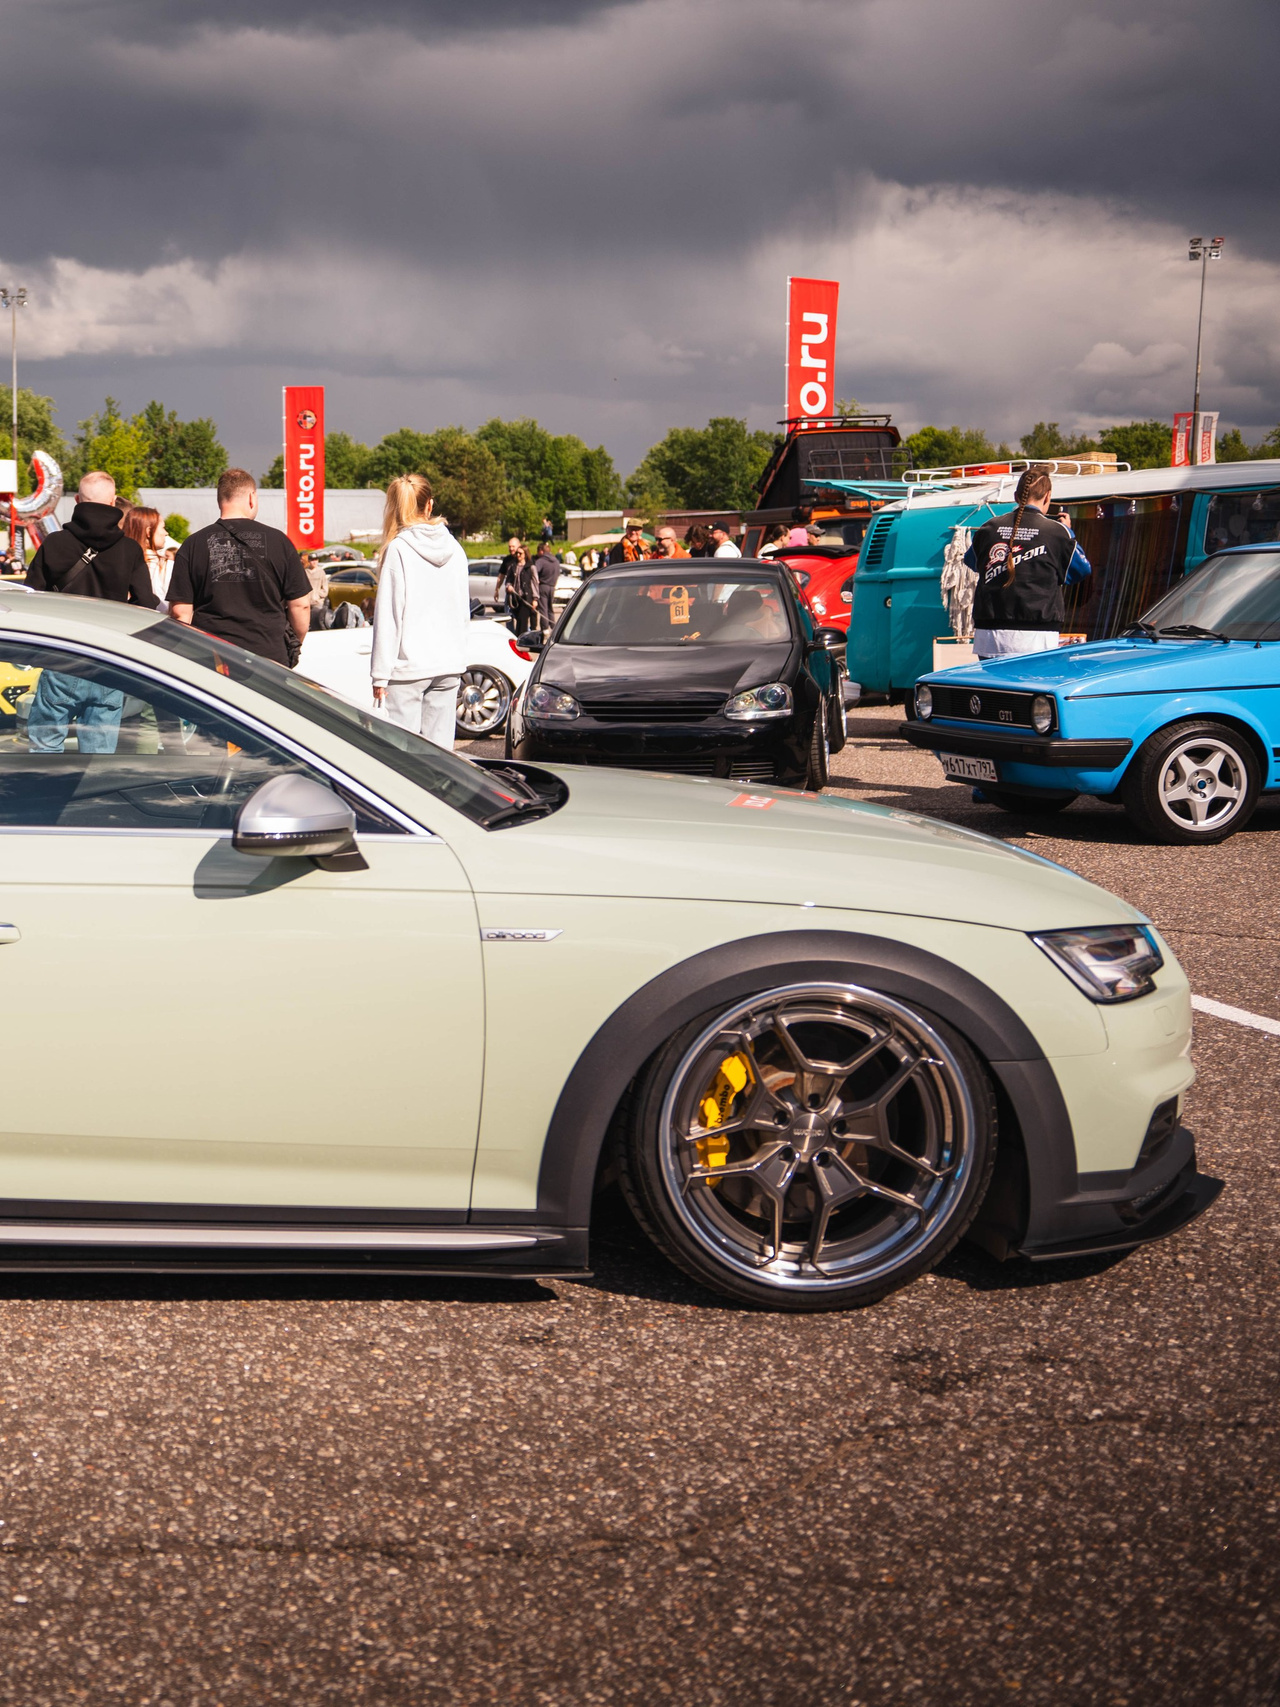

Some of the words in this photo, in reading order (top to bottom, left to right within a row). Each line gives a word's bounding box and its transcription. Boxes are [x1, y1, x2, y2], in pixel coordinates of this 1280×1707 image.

[297, 444, 315, 534] auto.ru
[674, 605, 684, 617] 61
[998, 709, 1013, 721] GTI
[976, 760, 992, 775] 797
[714, 1084, 731, 1124] brembo
